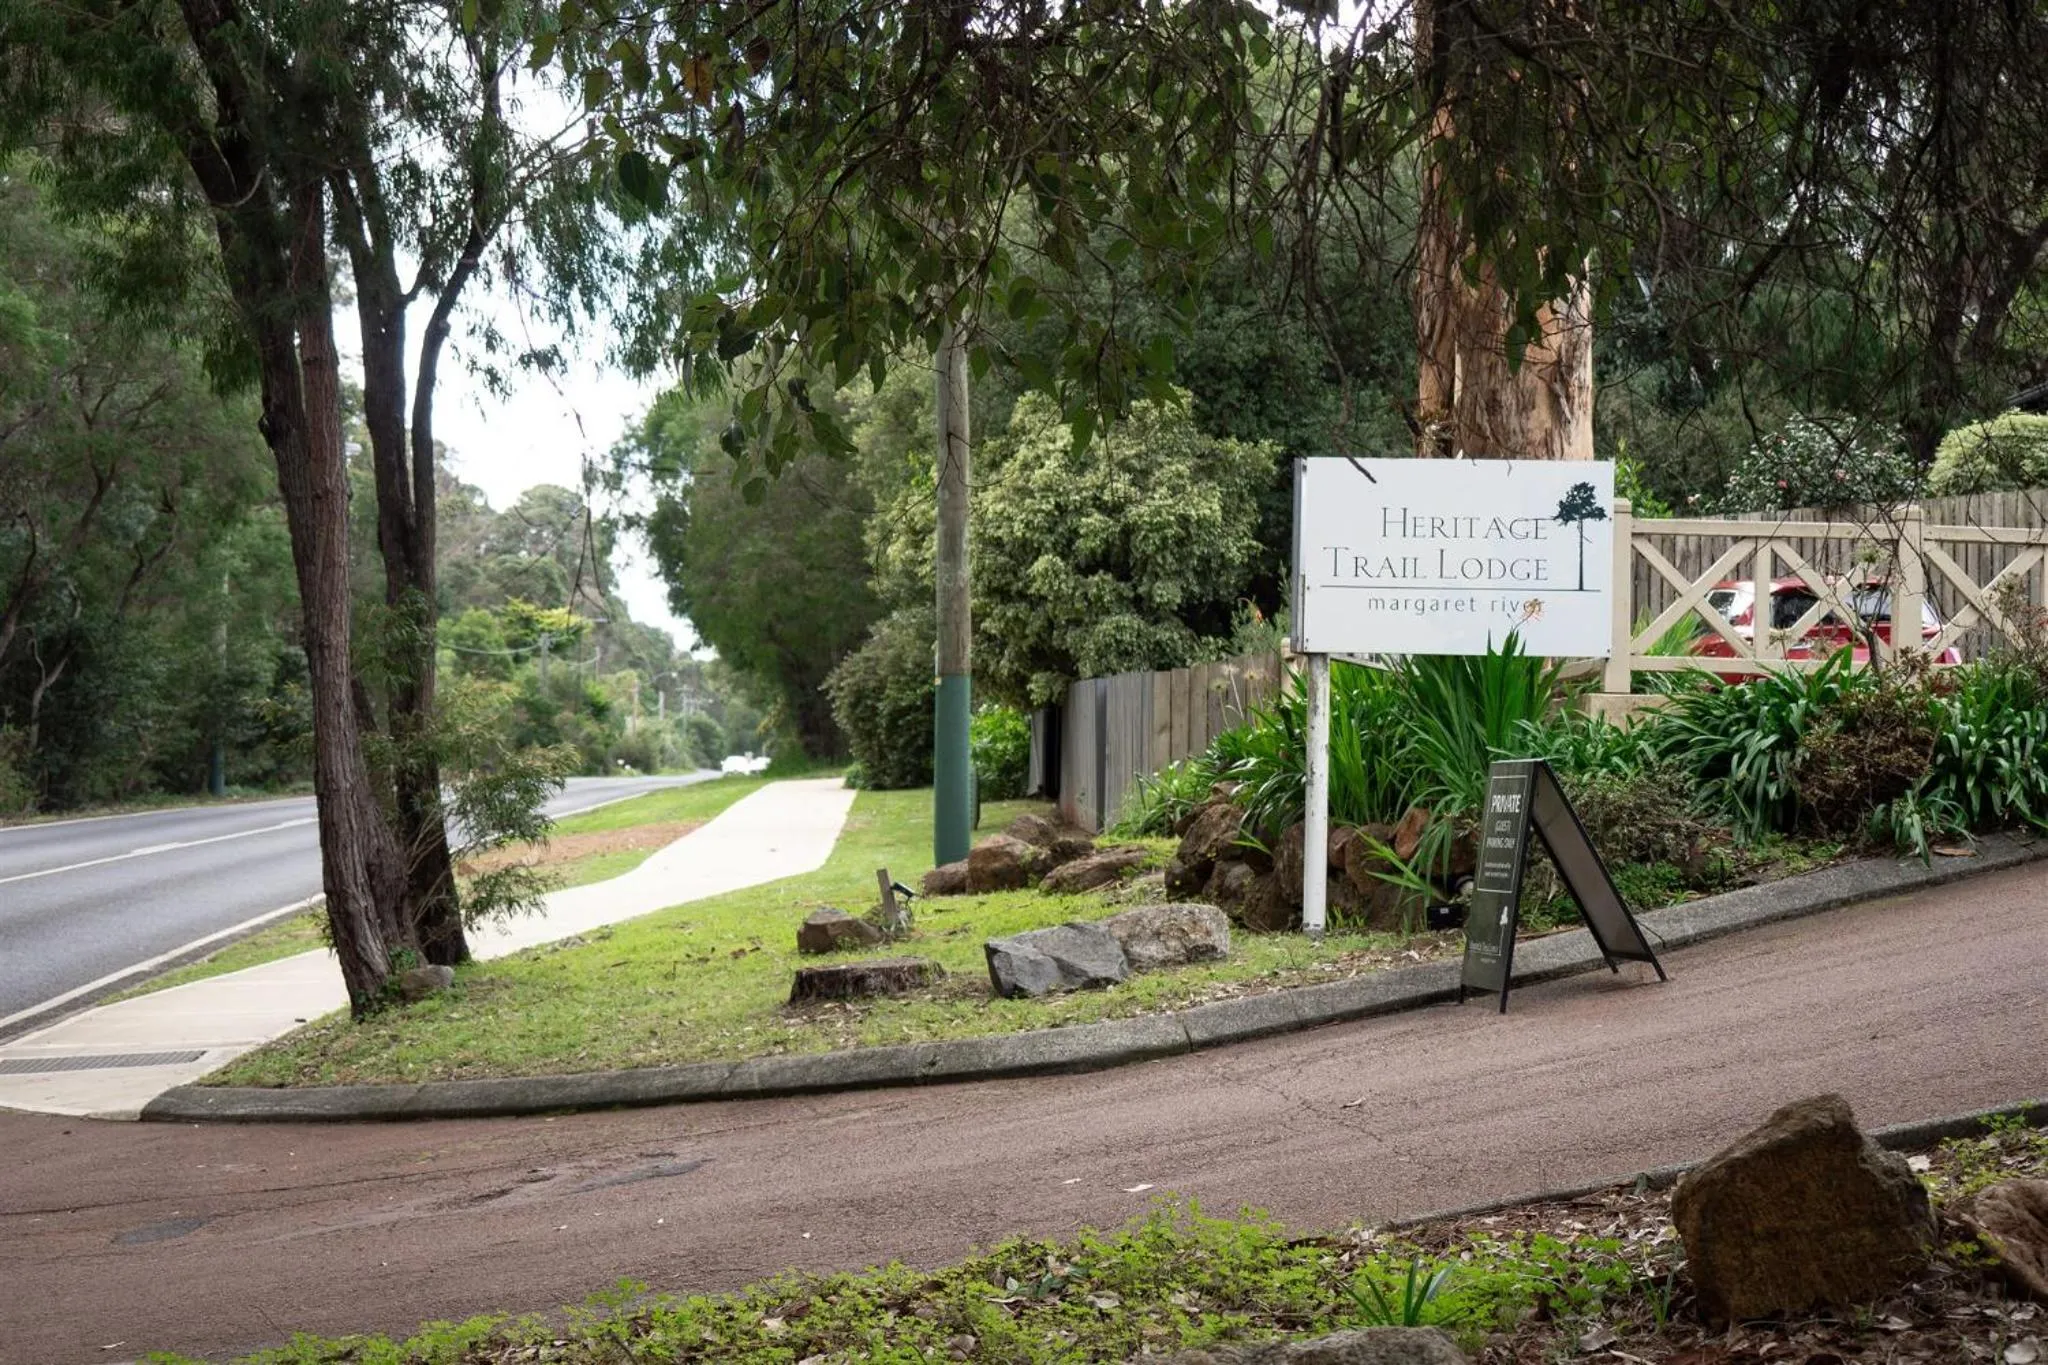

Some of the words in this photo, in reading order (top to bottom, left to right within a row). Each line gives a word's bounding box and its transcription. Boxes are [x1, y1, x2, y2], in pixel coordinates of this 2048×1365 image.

[1381, 506, 1548, 540] HERITAGE
[1322, 546, 1427, 579] TRAIL
[1439, 548, 1549, 581] LODGE
[1368, 597, 1476, 615] margaret
[1490, 794, 1522, 813] PRIVATE
